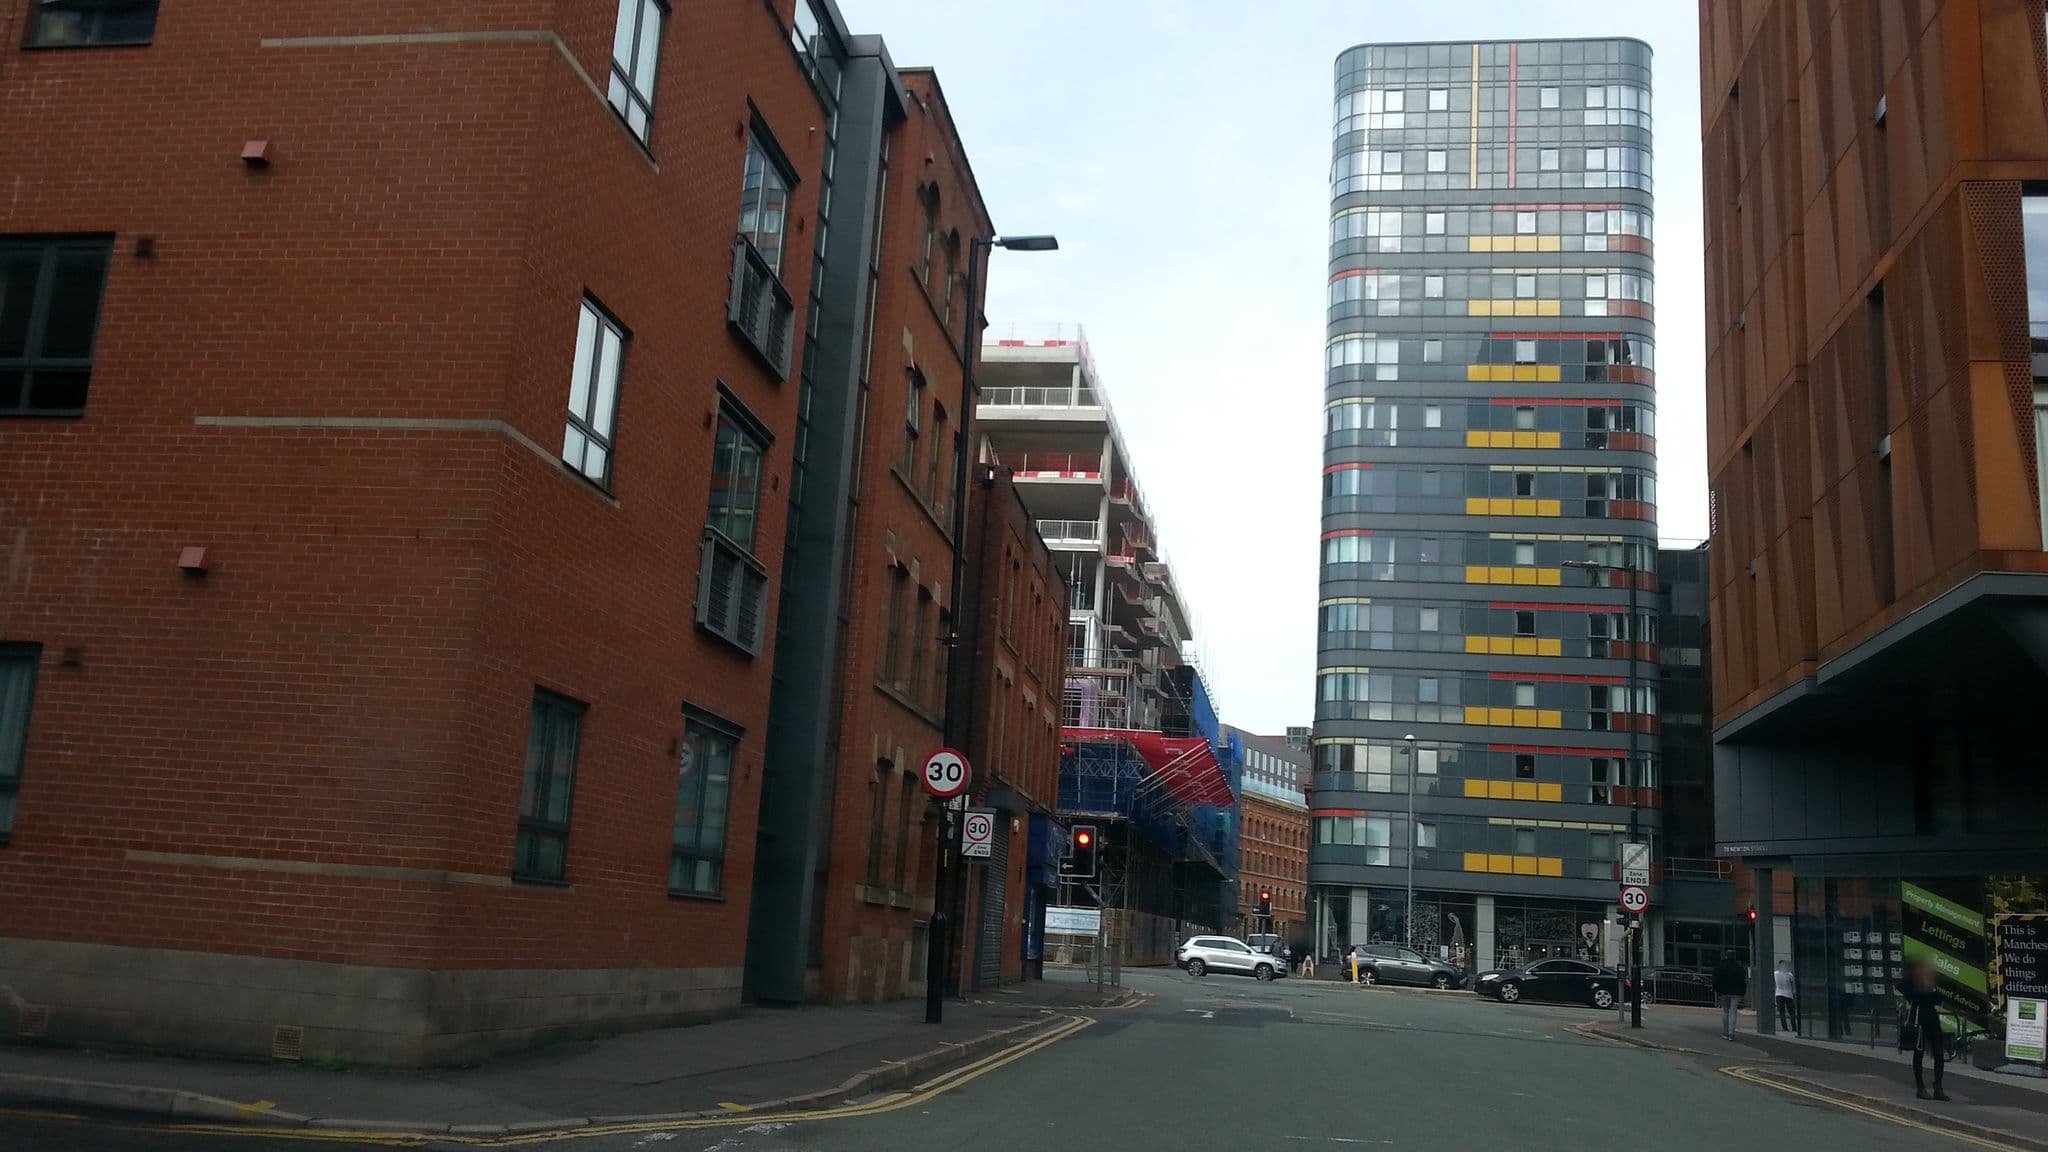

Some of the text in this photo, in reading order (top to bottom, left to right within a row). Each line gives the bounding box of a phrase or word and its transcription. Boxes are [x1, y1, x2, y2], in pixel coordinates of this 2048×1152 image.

[929, 762, 962, 782] 30
[969, 822, 987, 834] 30
[1625, 892, 1645, 905] 30
[1905, 890, 1980, 928] Property Management
[1921, 920, 1967, 949] Lettings
[2002, 924, 2036, 935] This is
[2004, 952, 2036, 963] We do
[2005, 967, 2037, 981] things
[1954, 993, 1980, 1011] Advice
